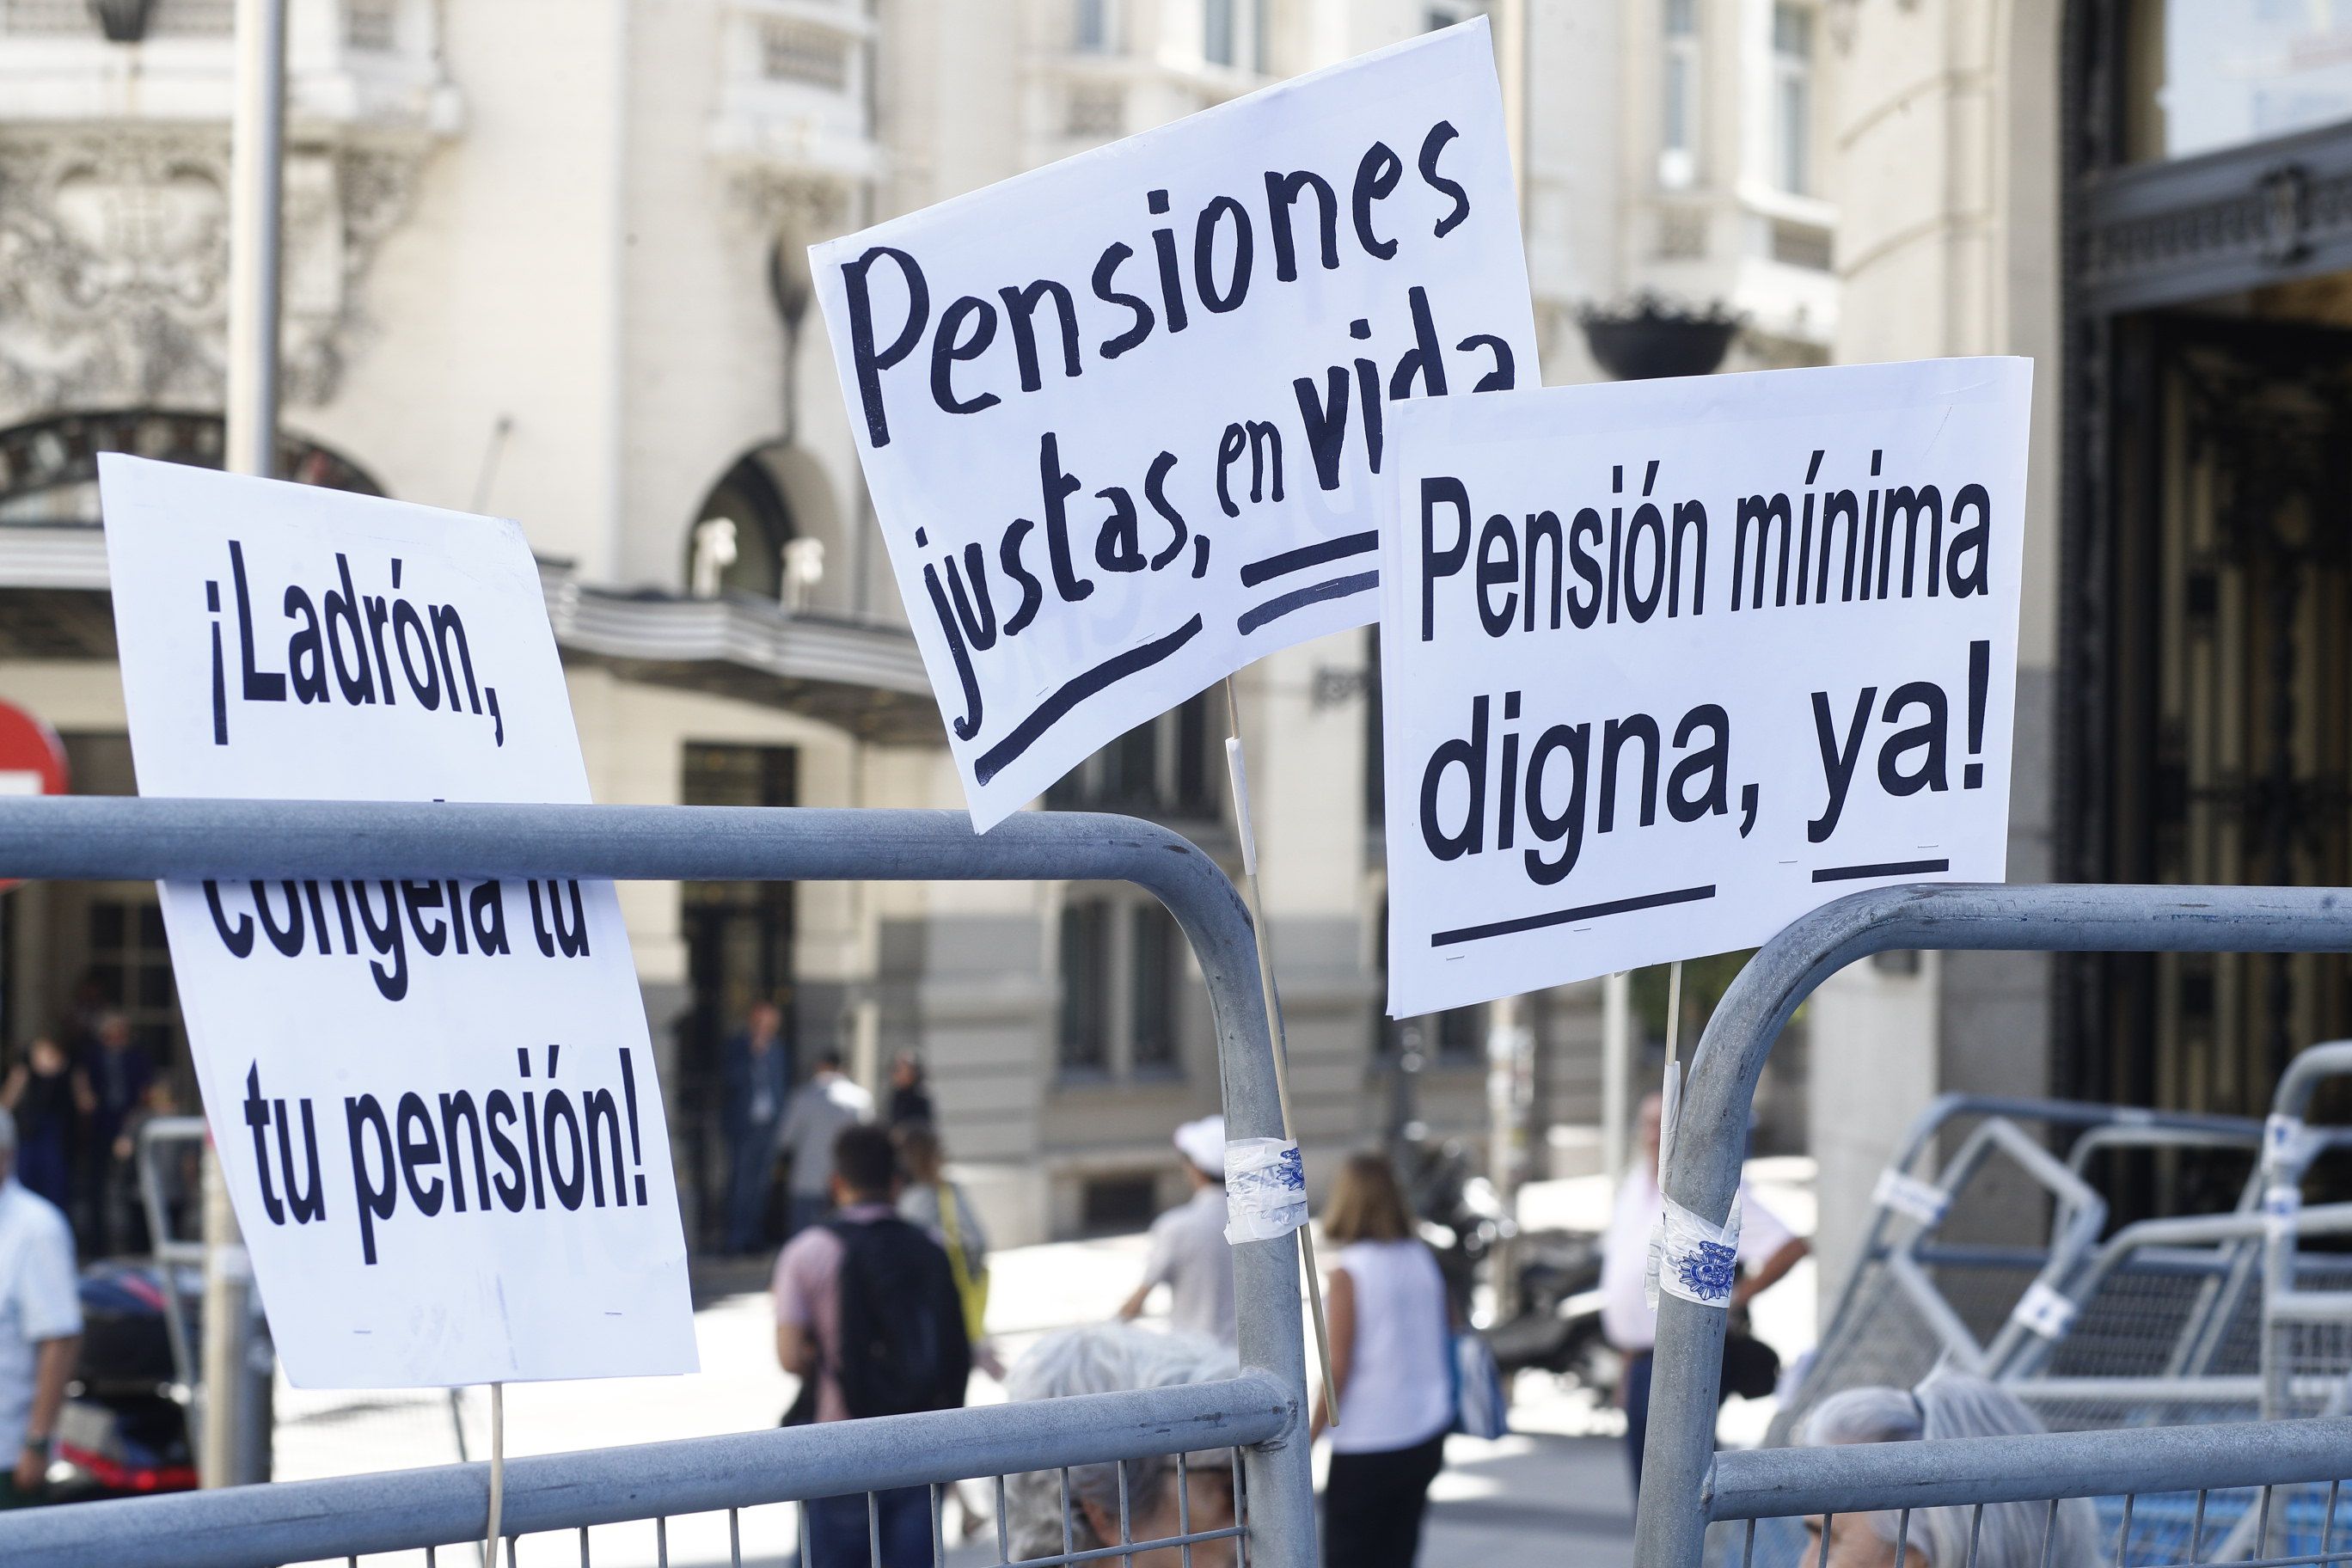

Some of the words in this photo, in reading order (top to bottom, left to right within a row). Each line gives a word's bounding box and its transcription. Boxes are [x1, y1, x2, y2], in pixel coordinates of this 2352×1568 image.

[841, 119, 1471, 449] Pensiones
[915, 432, 1211, 742] justas,
[1216, 420, 1285, 518] en
[1292, 285, 1516, 491] vida
[1420, 460, 1708, 642] Pensión
[1730, 449, 1991, 612] mínima
[205, 540, 504, 748] ¡Ladrón,
[1419, 686, 1760, 885] digna,
[1807, 640, 1990, 843] ya!
[243, 1057, 327, 1227] tu
[344, 1044, 648, 1265] pensión!
